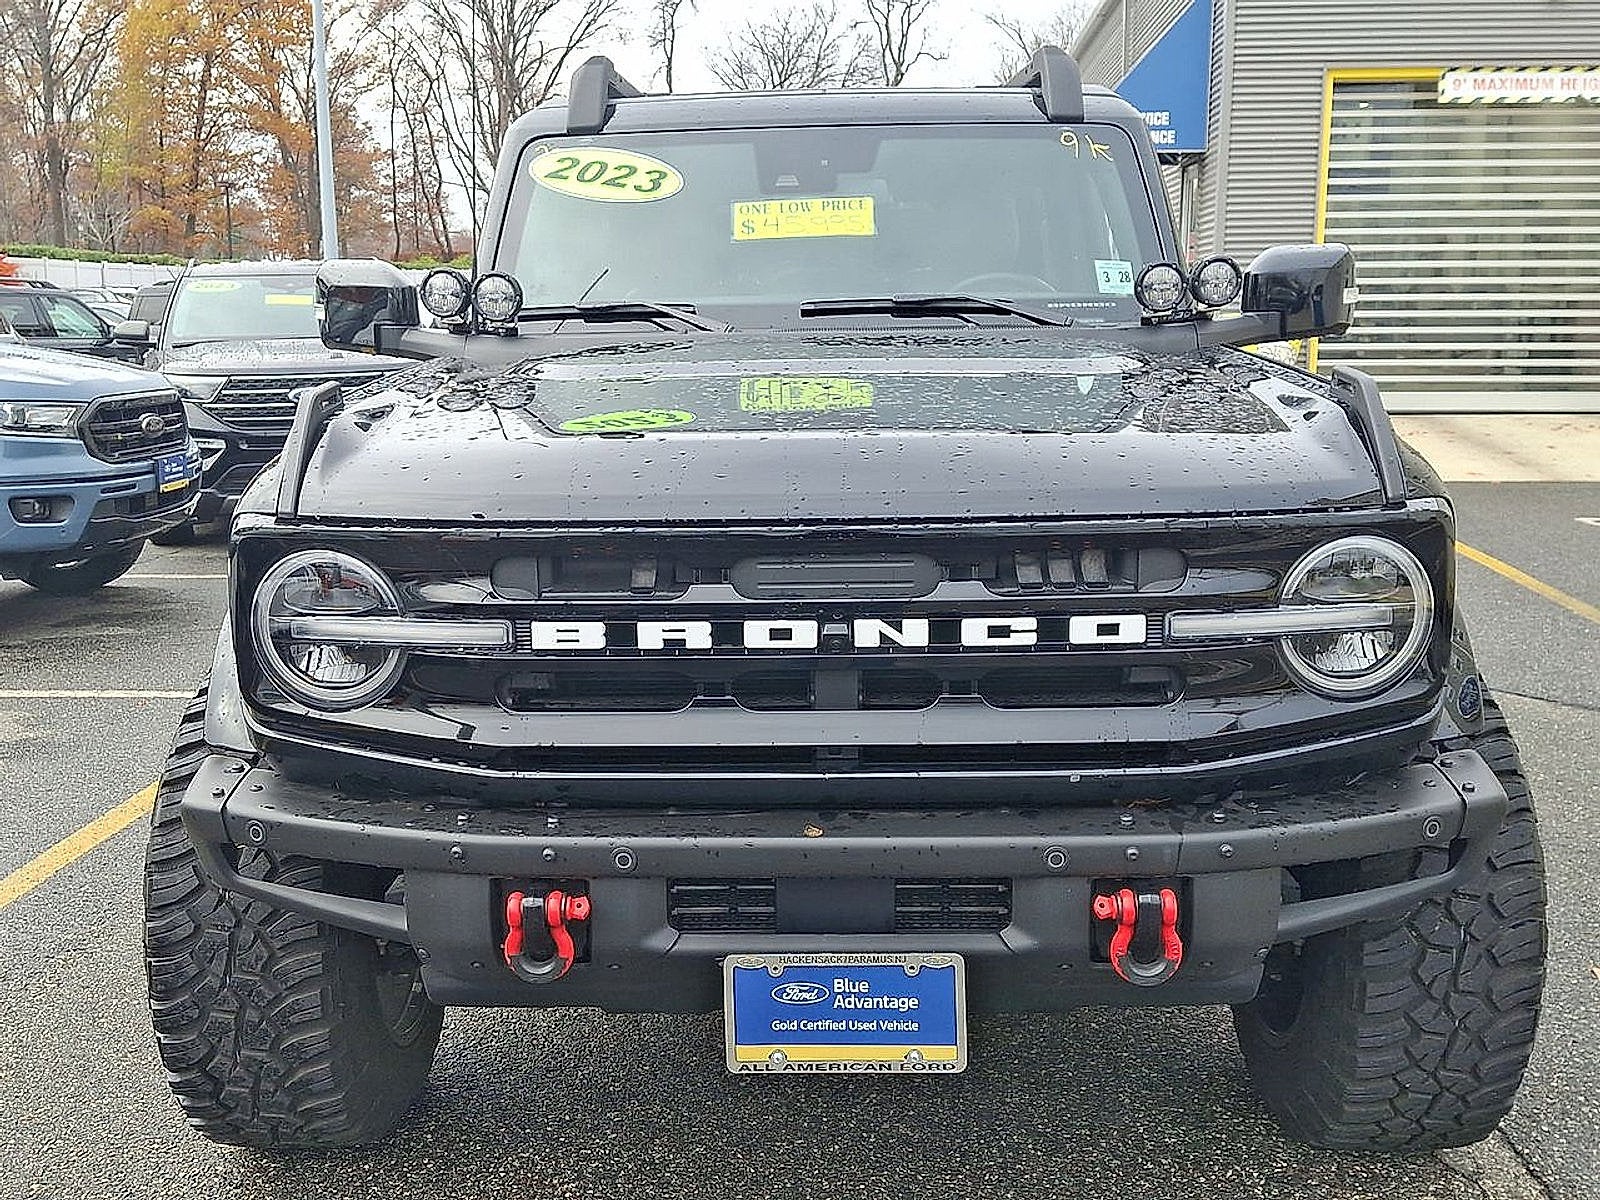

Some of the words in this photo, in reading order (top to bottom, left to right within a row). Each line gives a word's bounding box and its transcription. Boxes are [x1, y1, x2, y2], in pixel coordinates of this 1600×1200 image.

[1473, 77, 1554, 91] MAXIMUM
[544, 157, 668, 193] 2023
[739, 203, 770, 215] ONE
[780, 201, 812, 214] LOW
[822, 199, 866, 212] PRICE
[1102, 271, 1111, 283] 3
[1118, 271, 1132, 283] 28
[531, 614, 1147, 650] BRONCO
[834, 978, 870, 993] Blue
[834, 994, 919, 1012] Advantage
[771, 1019, 798, 1031] Gold
[800, 1019, 846, 1031] Certified
[849, 1019, 877, 1031] Used
[880, 1019, 919, 1031] Vehicle
[738, 1062, 777, 1072] ALL
[783, 1061, 892, 1072] AMERICAN
[900, 1061, 957, 1072] FORD
